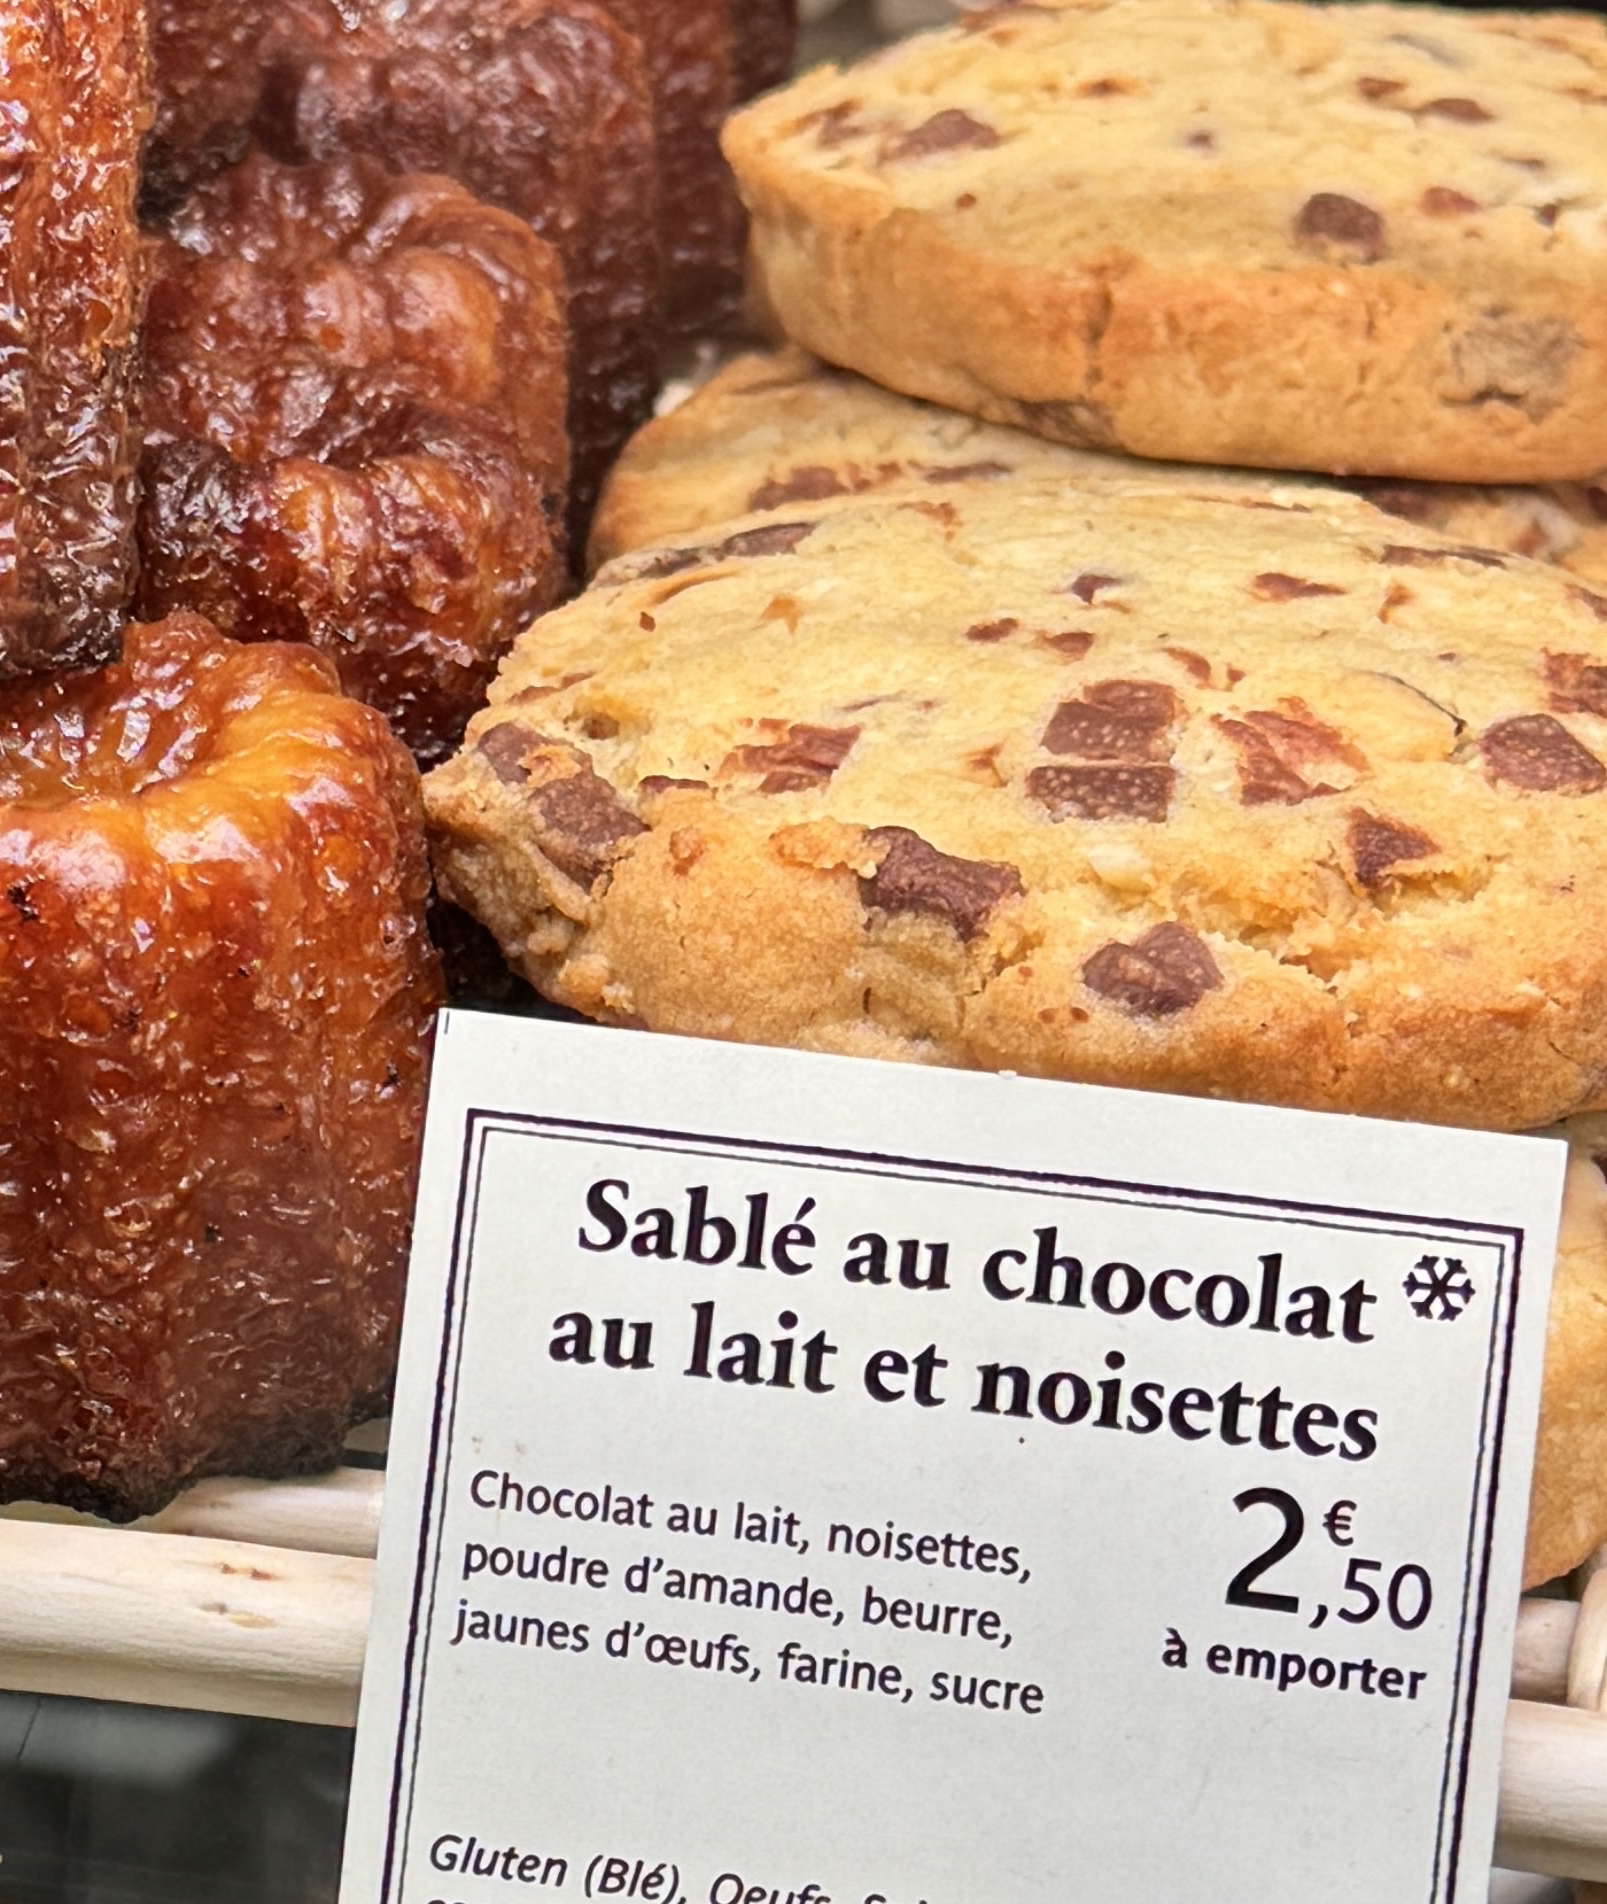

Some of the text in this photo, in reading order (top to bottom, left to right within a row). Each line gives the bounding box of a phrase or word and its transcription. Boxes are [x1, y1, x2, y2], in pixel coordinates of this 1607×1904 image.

[577, 1177, 1379, 1345] Sablé au chocolat
[548, 1299, 1379, 1463] au lait et noisettes
[469, 1469, 1032, 1585] Chocolat au lait, noisettes,
[461, 1541, 1013, 1650] poudre d’amande, beurre,
[448, 1597, 1045, 1715] jaunes d’œufs, farine, sucre
[1160, 1626, 1429, 1701] à emporter
[429, 1833, 569, 1888] Gluten
